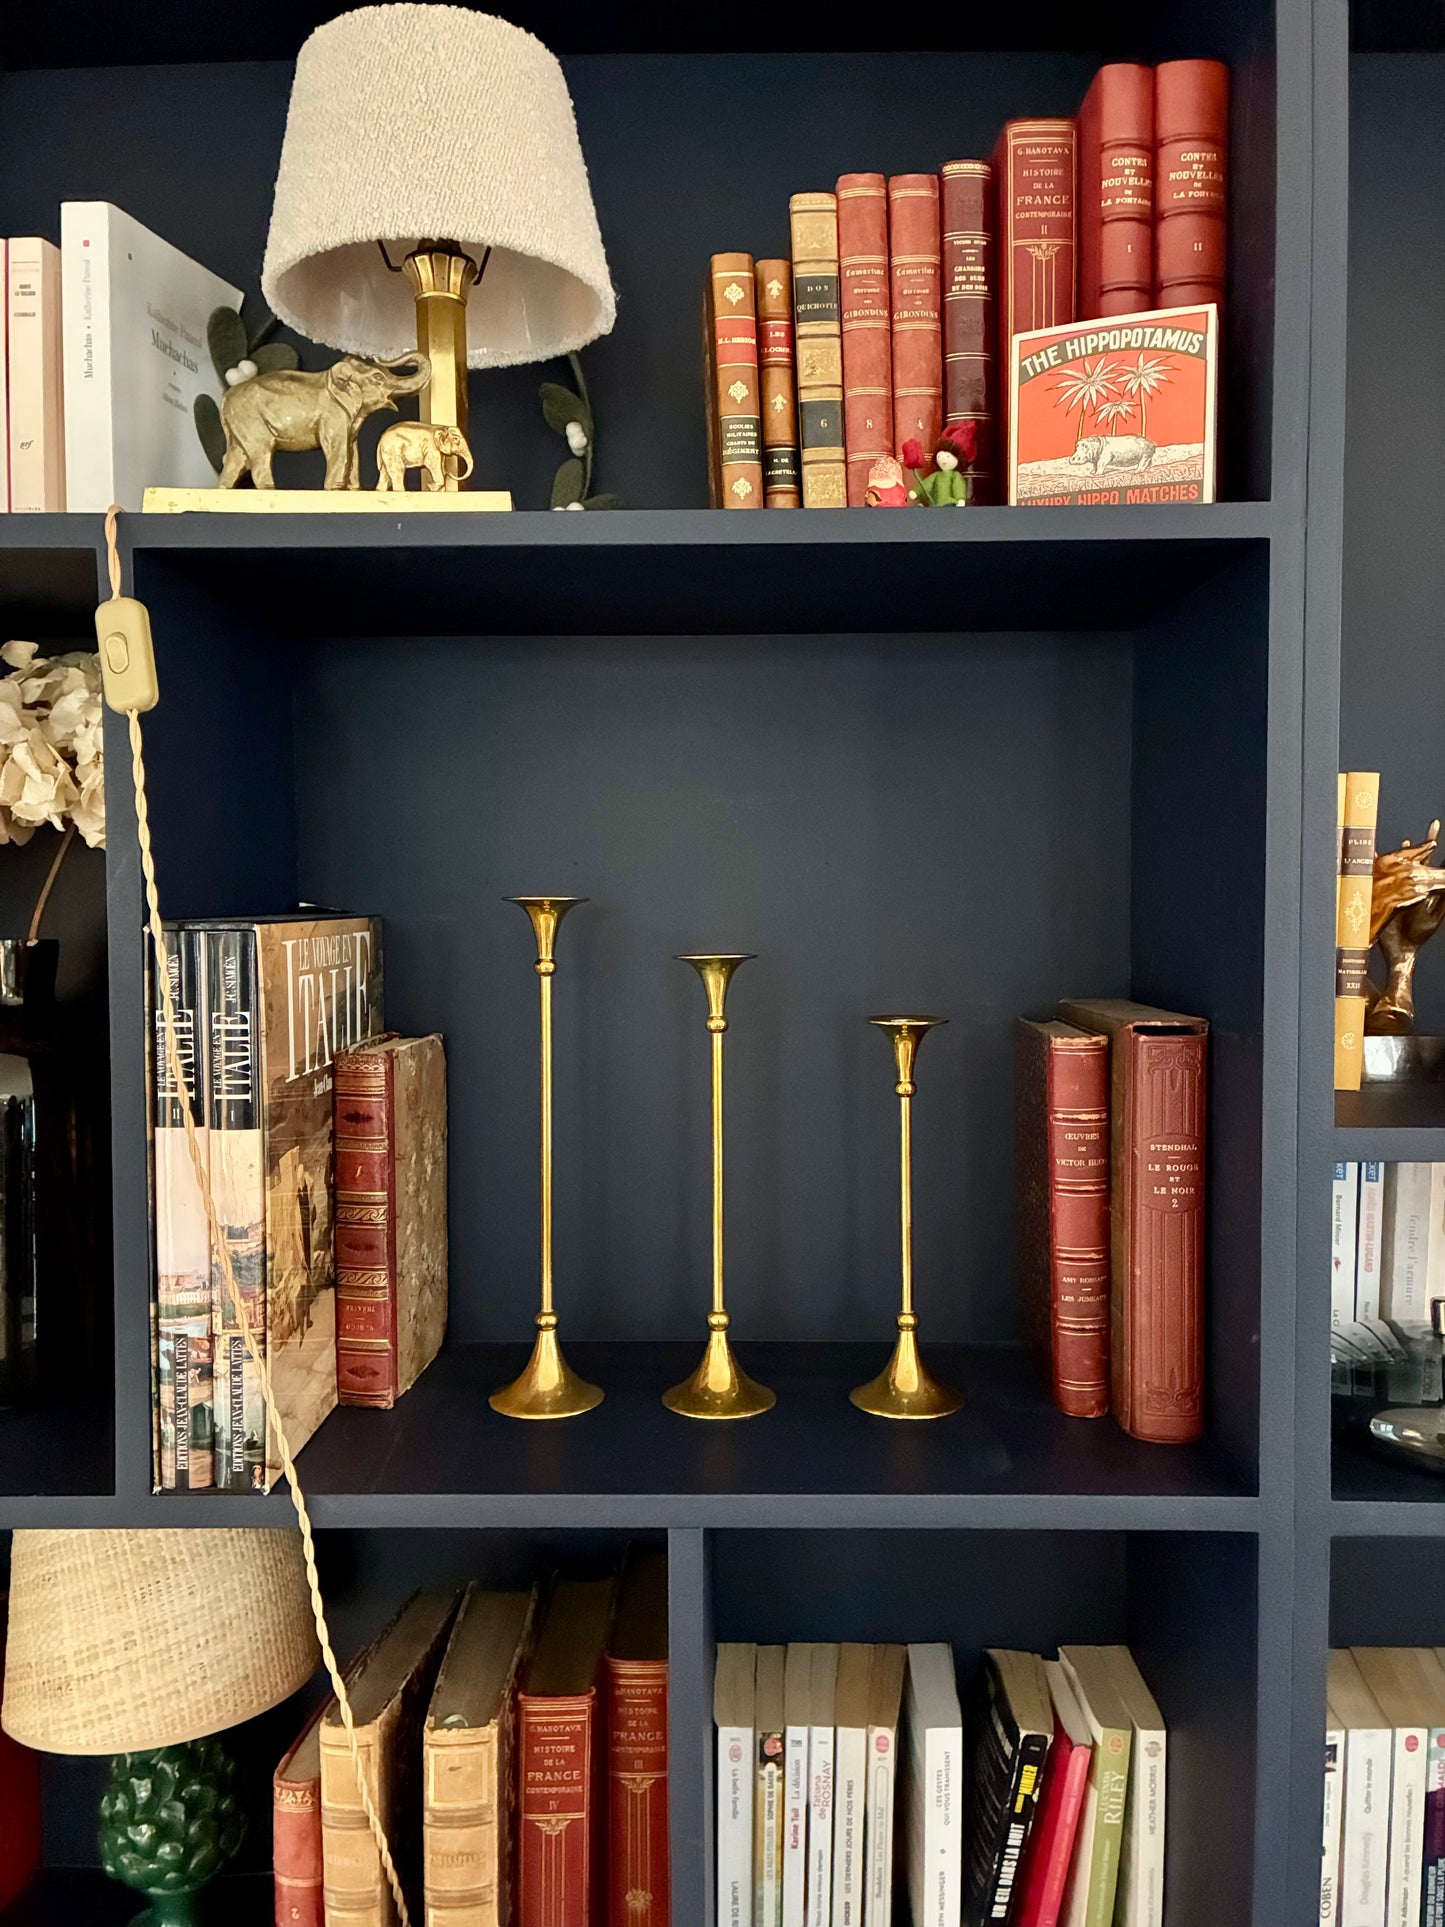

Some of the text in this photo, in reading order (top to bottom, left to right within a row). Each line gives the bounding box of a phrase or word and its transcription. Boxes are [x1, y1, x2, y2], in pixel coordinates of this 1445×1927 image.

[1112, 157, 1147, 167] CONTES
[1022, 168, 1064, 177] HISTOIRE
[1124, 168, 1136, 176] ET
[1033, 182, 1043, 190] DE
[1016, 195, 1070, 206] FRANCE
[1173, 191, 1185, 199] LA
[1101, 198, 1112, 207] LA
[1015, 210, 1072, 219] CONTEMPORAINE
[1194, 243, 1202, 251] II
[806, 284, 829, 292] DON
[844, 308, 888, 319] GIRONDINS
[894, 310, 938, 320] GIRONDINS
[84, 333, 93, 378] Muchachas
[151, 328, 198, 373] Muchachas
[1021, 327, 1204, 377] THE HIPPOPOTAMUS
[820, 419, 828, 428] 6
[866, 419, 873, 430] 8
[916, 419, 924, 430] 4
[1078, 484, 1198, 506] HIPPO MATCHES
[298, 934, 352, 971] LE VOYAGE EN
[282, 930, 372, 1084] ITALIE
[156, 1032, 165, 1046] EN
[213, 1034, 221, 1049] EN
[212, 1010, 252, 1104] ITALIE
[157, 1075, 166, 1086] LE
[213, 1078, 222, 1088] LE
[172, 1108, 180, 1120] II
[231, 1110, 235, 1121] I
[1064, 1132, 1099, 1140] ŒUVRES
[1150, 1143, 1197, 1152] STENDHAL
[1056, 1158, 1084, 1167] VICTOR
[1148, 1164, 1198, 1172] LE ROUGE
[1154, 1187, 1195, 1195] LE NOIR
[1172, 1198, 1178, 1208] 2
[1334, 1223, 1342, 1246] Minier
[1333, 1310, 1340, 1318] La
[176, 1431, 188, 1470] EDITIONS
[232, 1434, 244, 1472] EDITIONS
[618, 1707, 657, 1715] HISTOIRE
[613, 1731, 664, 1740] FRANCE
[534, 1745, 576, 1753] HISTOIRE
[554, 1758, 565, 1766] LA
[527, 1771, 581, 1782] FRANCE
[791, 1759, 800, 1800] La décision
[1018, 1765, 1038, 1795] MINIER
[526, 1785, 583, 1794] CONTEMPORAINE
[731, 1769, 739, 1820] La belle famille
[768, 1790, 774, 1798] DE
[814, 1776, 822, 1808] Tatiana
[818, 1760, 832, 1820] de ROSNAY
[1100, 1770, 1110, 1812] LUCINDA
[1104, 1771, 1125, 1824] RILEY
[548, 1801, 559, 1810] IV
[847, 1817, 853, 1826] DE
[1148, 1798, 1156, 1835] HEATHER
[791, 1808, 799, 1849] Karine Tuil
[991, 1823, 1025, 1918] UN ŒIL DANS LA NUIT
[1437, 1876, 1445, 1884] LA
[938, 1871, 946, 1910] MESSINGER
[1436, 1886, 1444, 1901] SOUS
[731, 1881, 739, 1917] LAURE DE
[1320, 1877, 1332, 1918] COBEN
[1436, 1902, 1444, 1918] FORT
